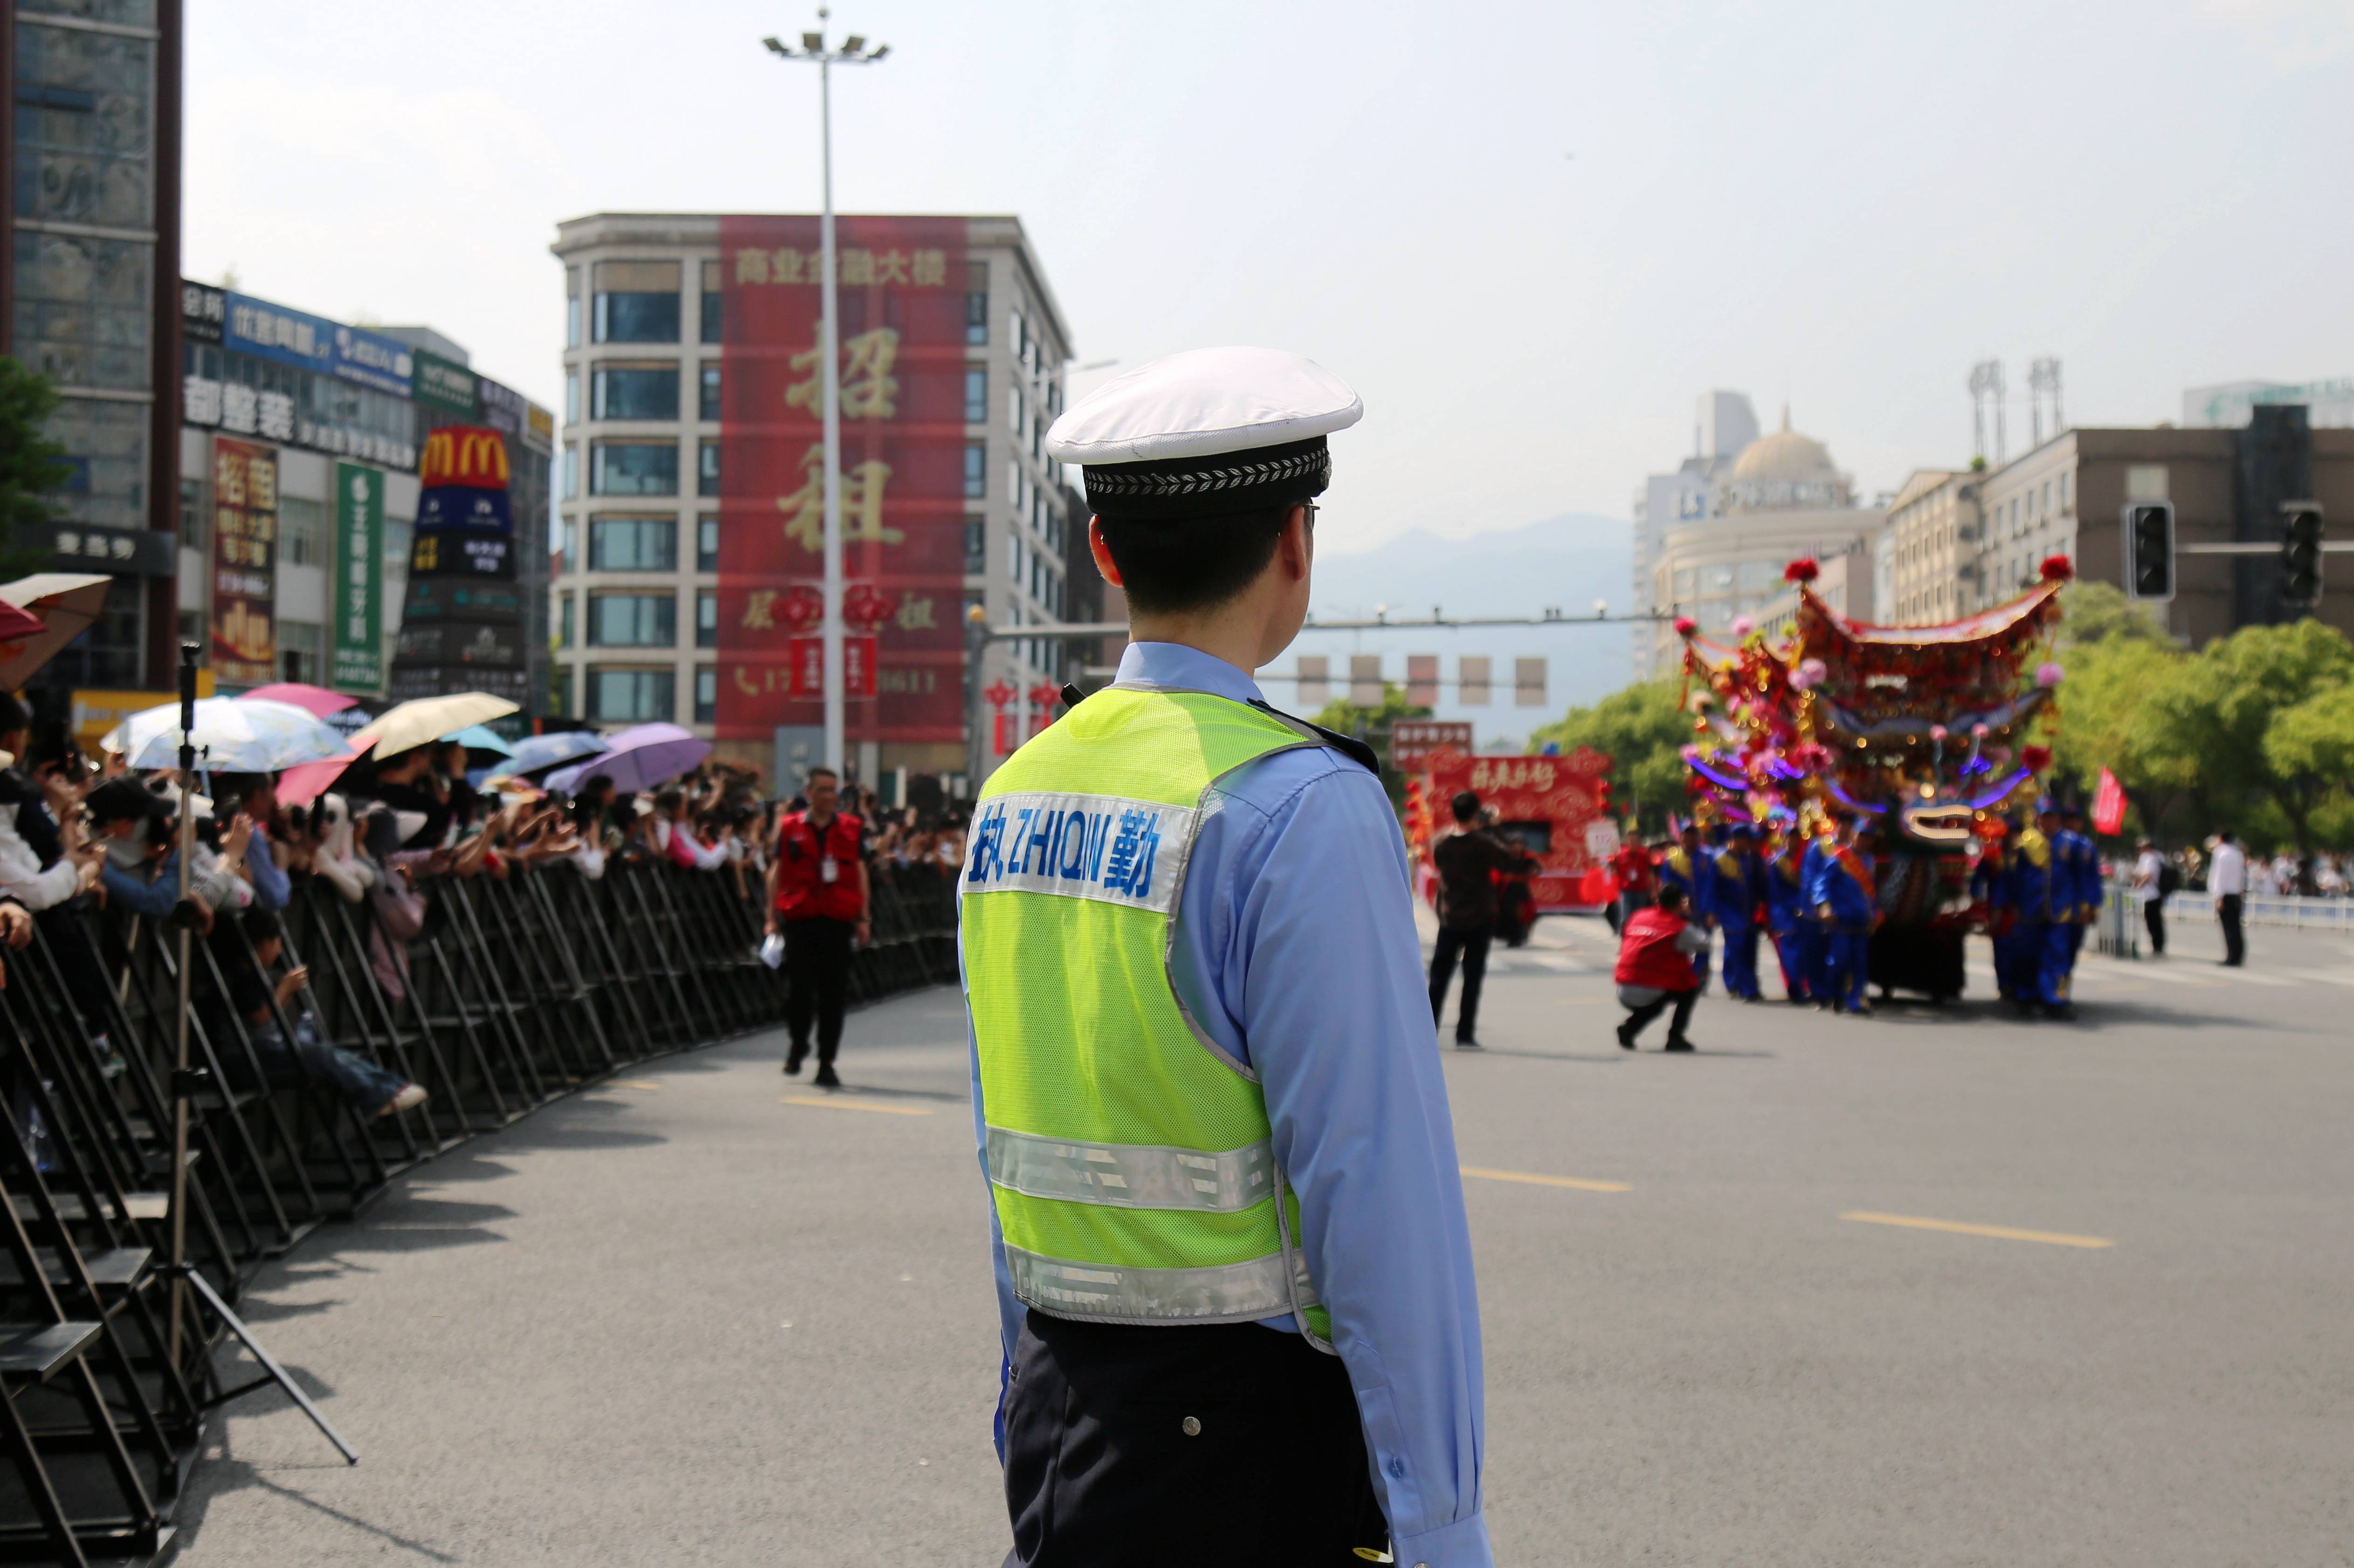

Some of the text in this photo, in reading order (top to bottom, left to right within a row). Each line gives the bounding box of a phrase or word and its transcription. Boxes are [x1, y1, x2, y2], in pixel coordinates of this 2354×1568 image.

[776, 320, 905, 553] 招租
[56, 530, 136, 561] 麦当劳
[968, 803, 1007, 883] 执
[1104, 809, 1161, 898] 勤
